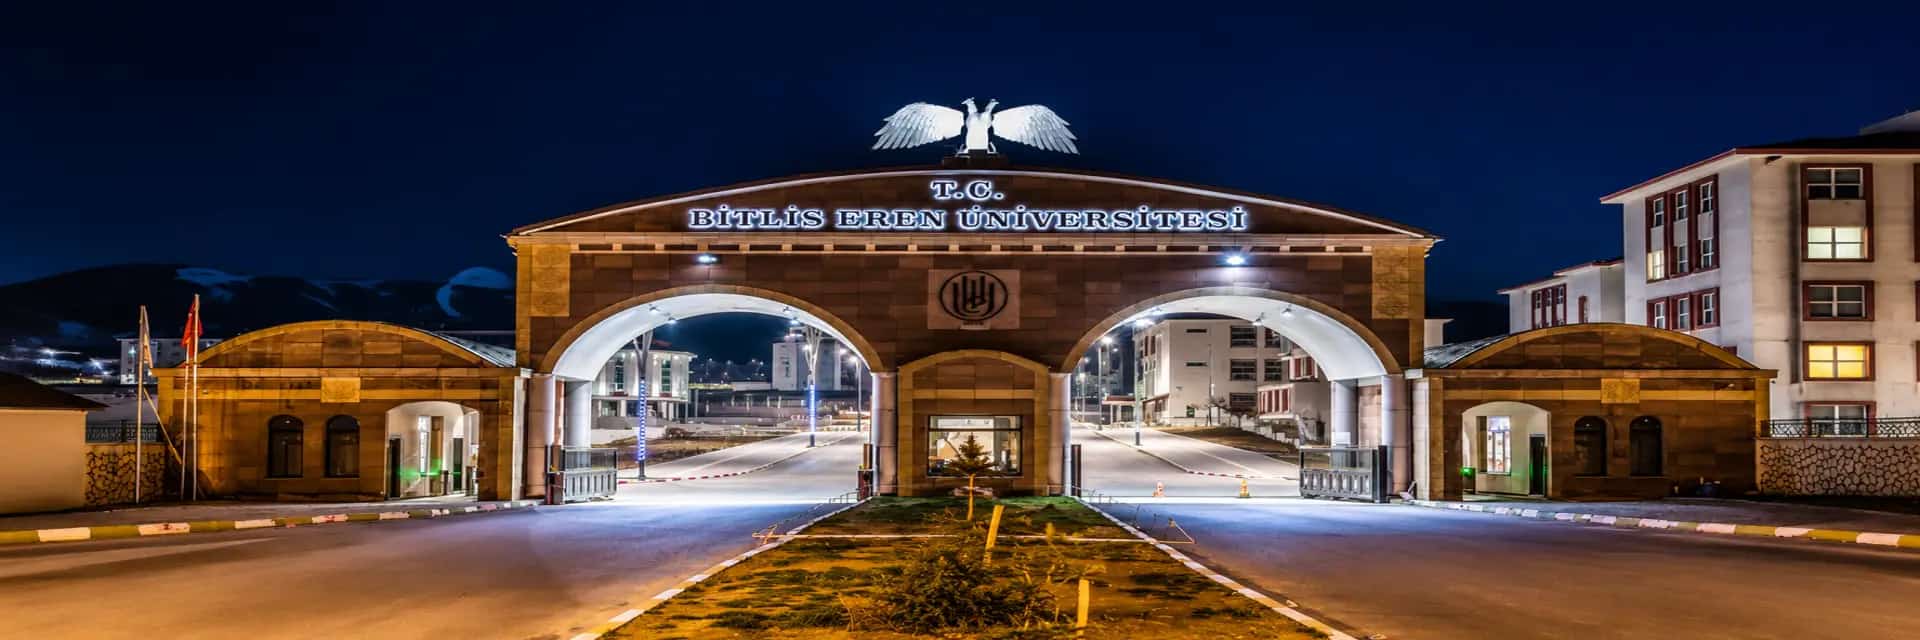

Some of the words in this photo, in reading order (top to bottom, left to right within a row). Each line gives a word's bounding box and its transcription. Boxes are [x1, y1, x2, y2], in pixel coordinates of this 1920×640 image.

[930, 180, 1004, 200] T.C.
[688, 204, 825, 229] BİTLİS
[835, 208, 946, 230] EREN
